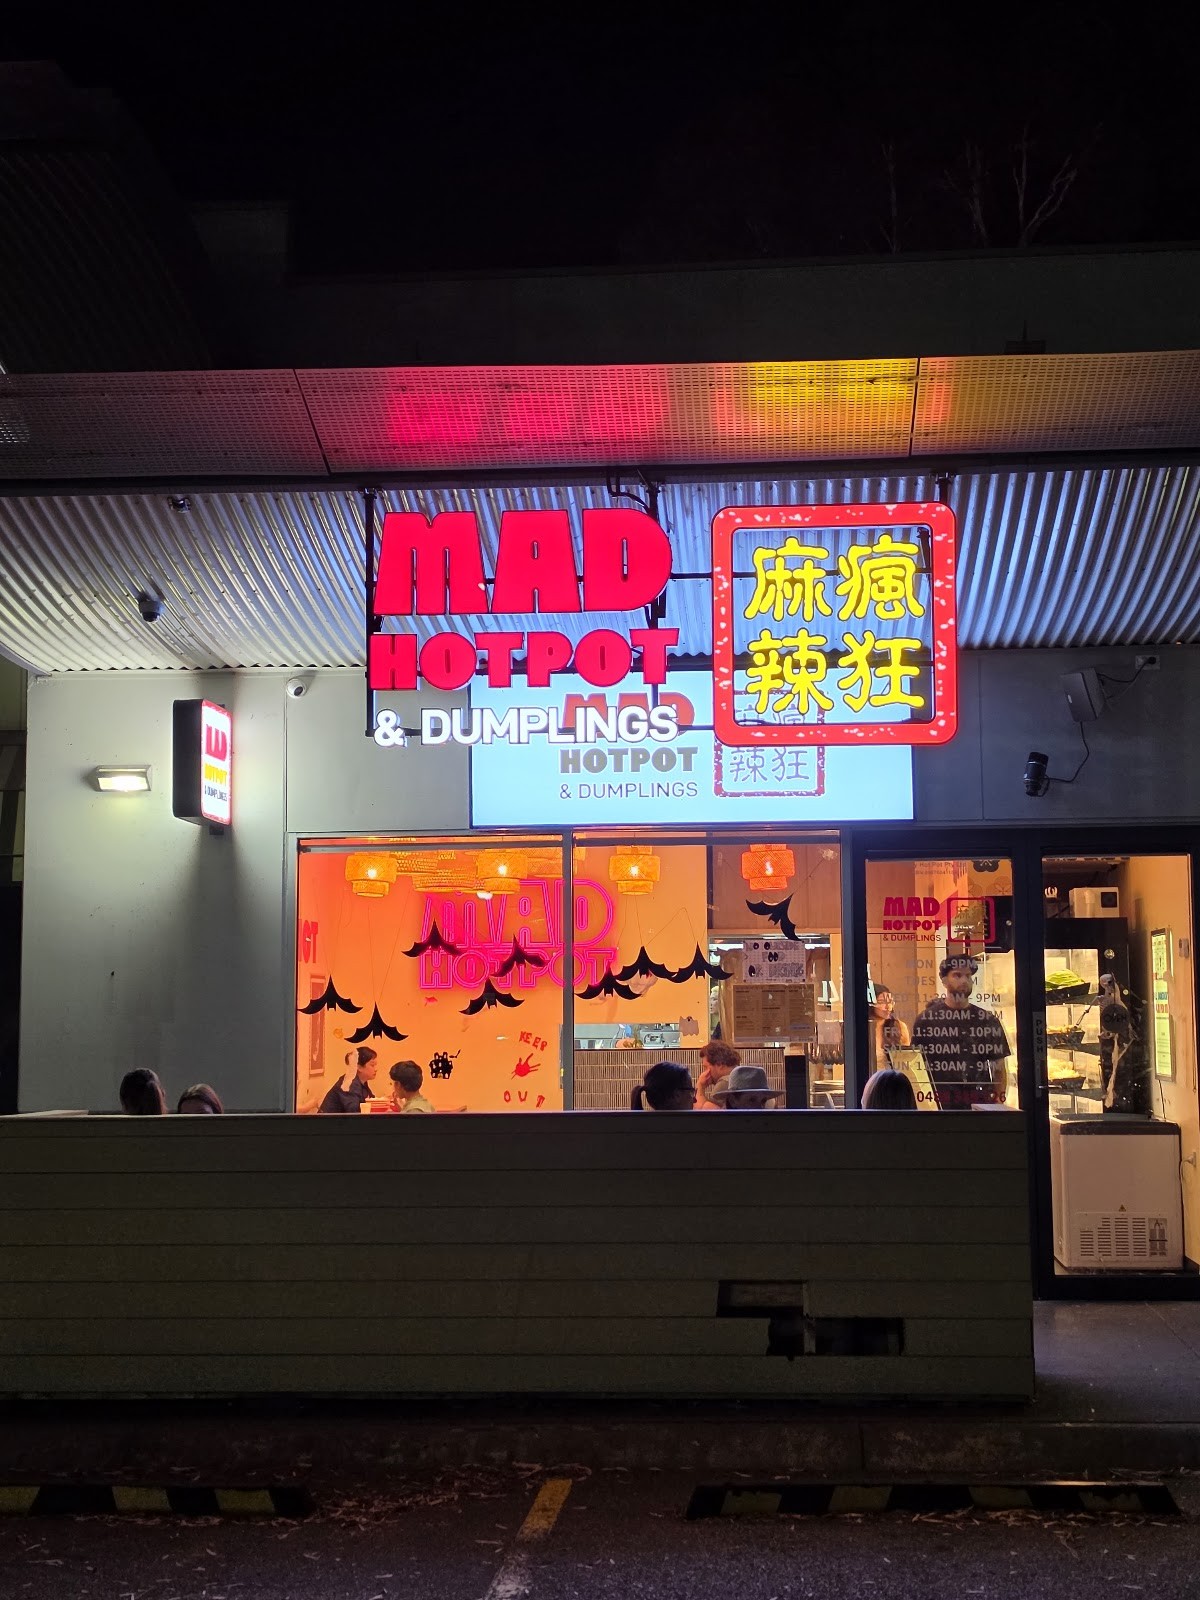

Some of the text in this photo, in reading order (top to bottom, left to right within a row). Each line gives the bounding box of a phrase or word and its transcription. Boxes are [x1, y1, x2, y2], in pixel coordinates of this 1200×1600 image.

[374, 508, 673, 616] MAD
[369, 628, 679, 691] HOTPOT
[373, 705, 679, 747] & DUMPLINGS
[560, 747, 698, 774] HOTPOT
[559, 782, 699, 799] & DUMPLINGS
[884, 897, 941, 916] MAD
[883, 920, 942, 931] HOTPOT
[976, 993, 1001, 1003] 9PM
[978, 1010, 1003, 1020] 9PM
[519, 1031, 548, 1052] KEEP
[969, 1027, 1002, 1037] 10PM
[1036, 1019, 1045, 1052] PUSH
[971, 1044, 1004, 1054] 10PM
